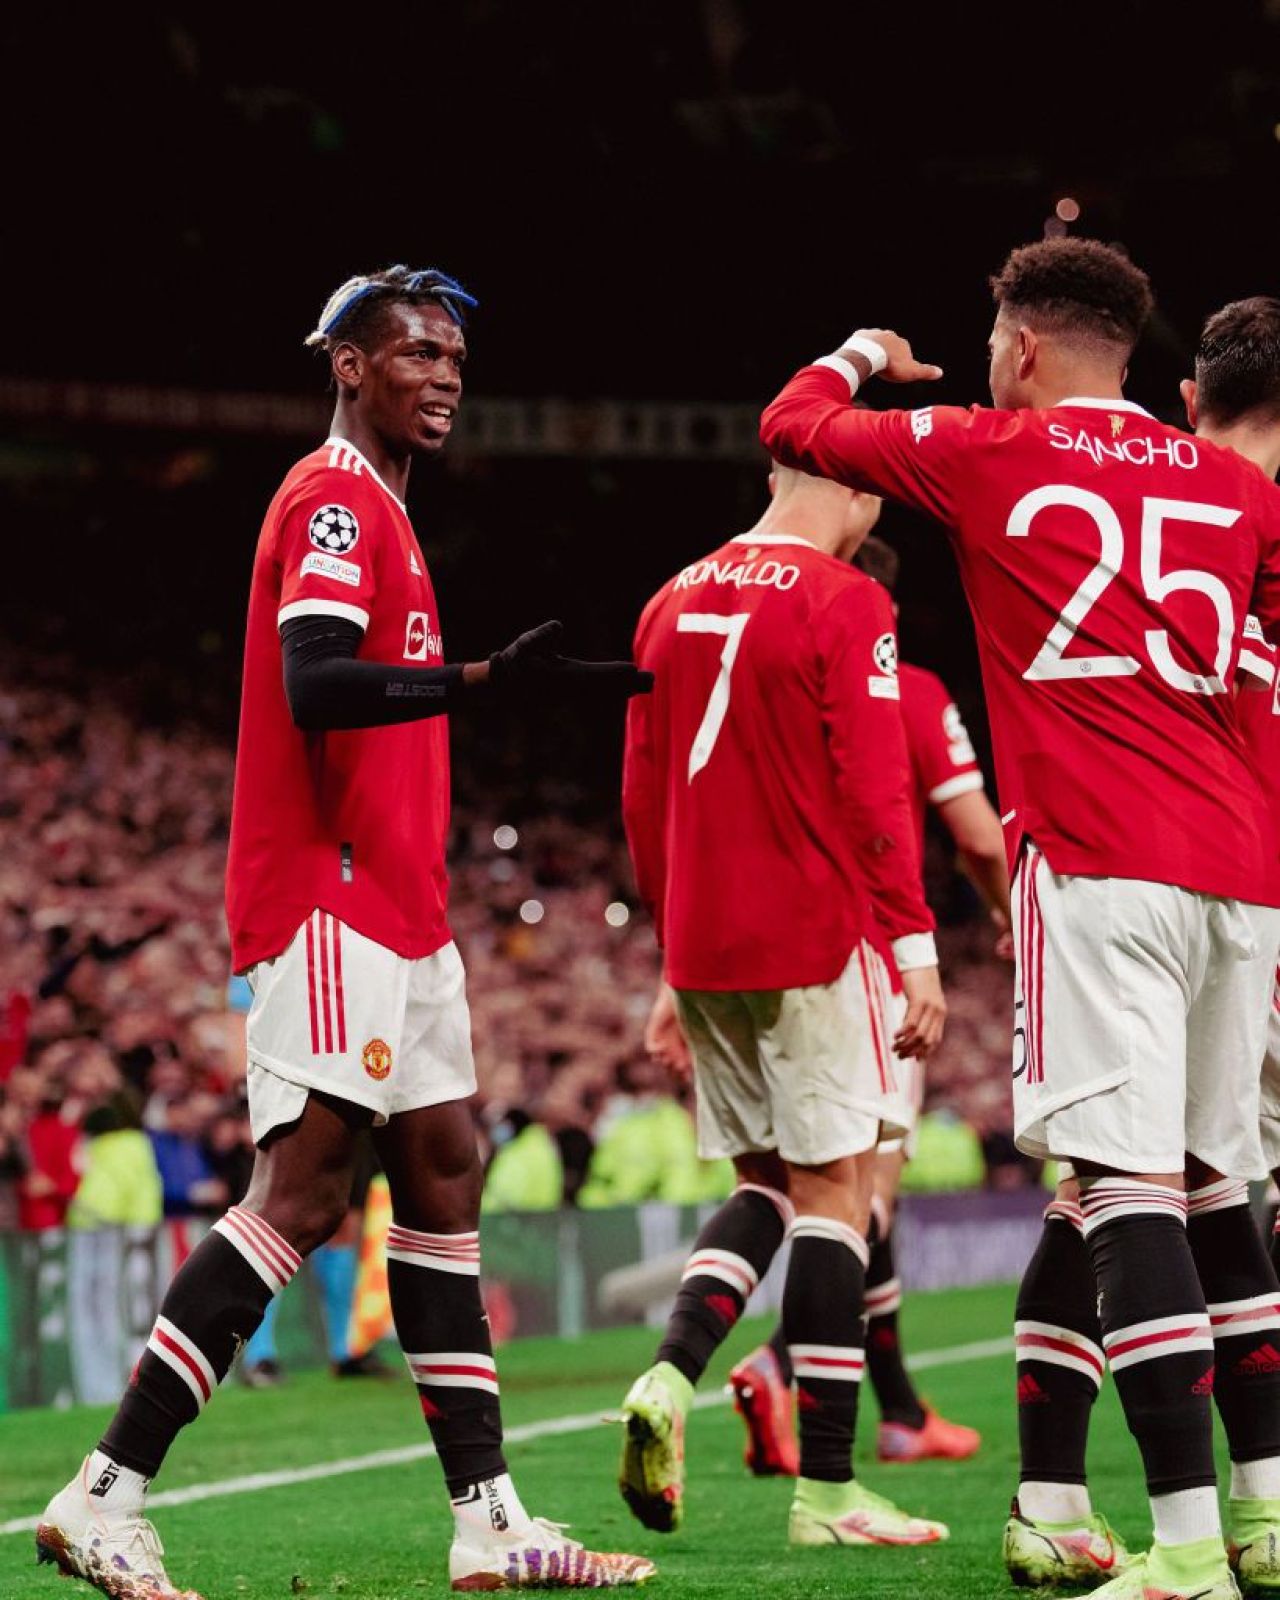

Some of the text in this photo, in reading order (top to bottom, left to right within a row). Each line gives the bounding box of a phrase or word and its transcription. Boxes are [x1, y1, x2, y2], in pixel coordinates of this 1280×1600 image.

[1048, 424, 1199, 470] SANCHO
[673, 560, 801, 591] RONALDO
[1006, 485, 1244, 695] 25
[676, 613, 751, 786] 7
